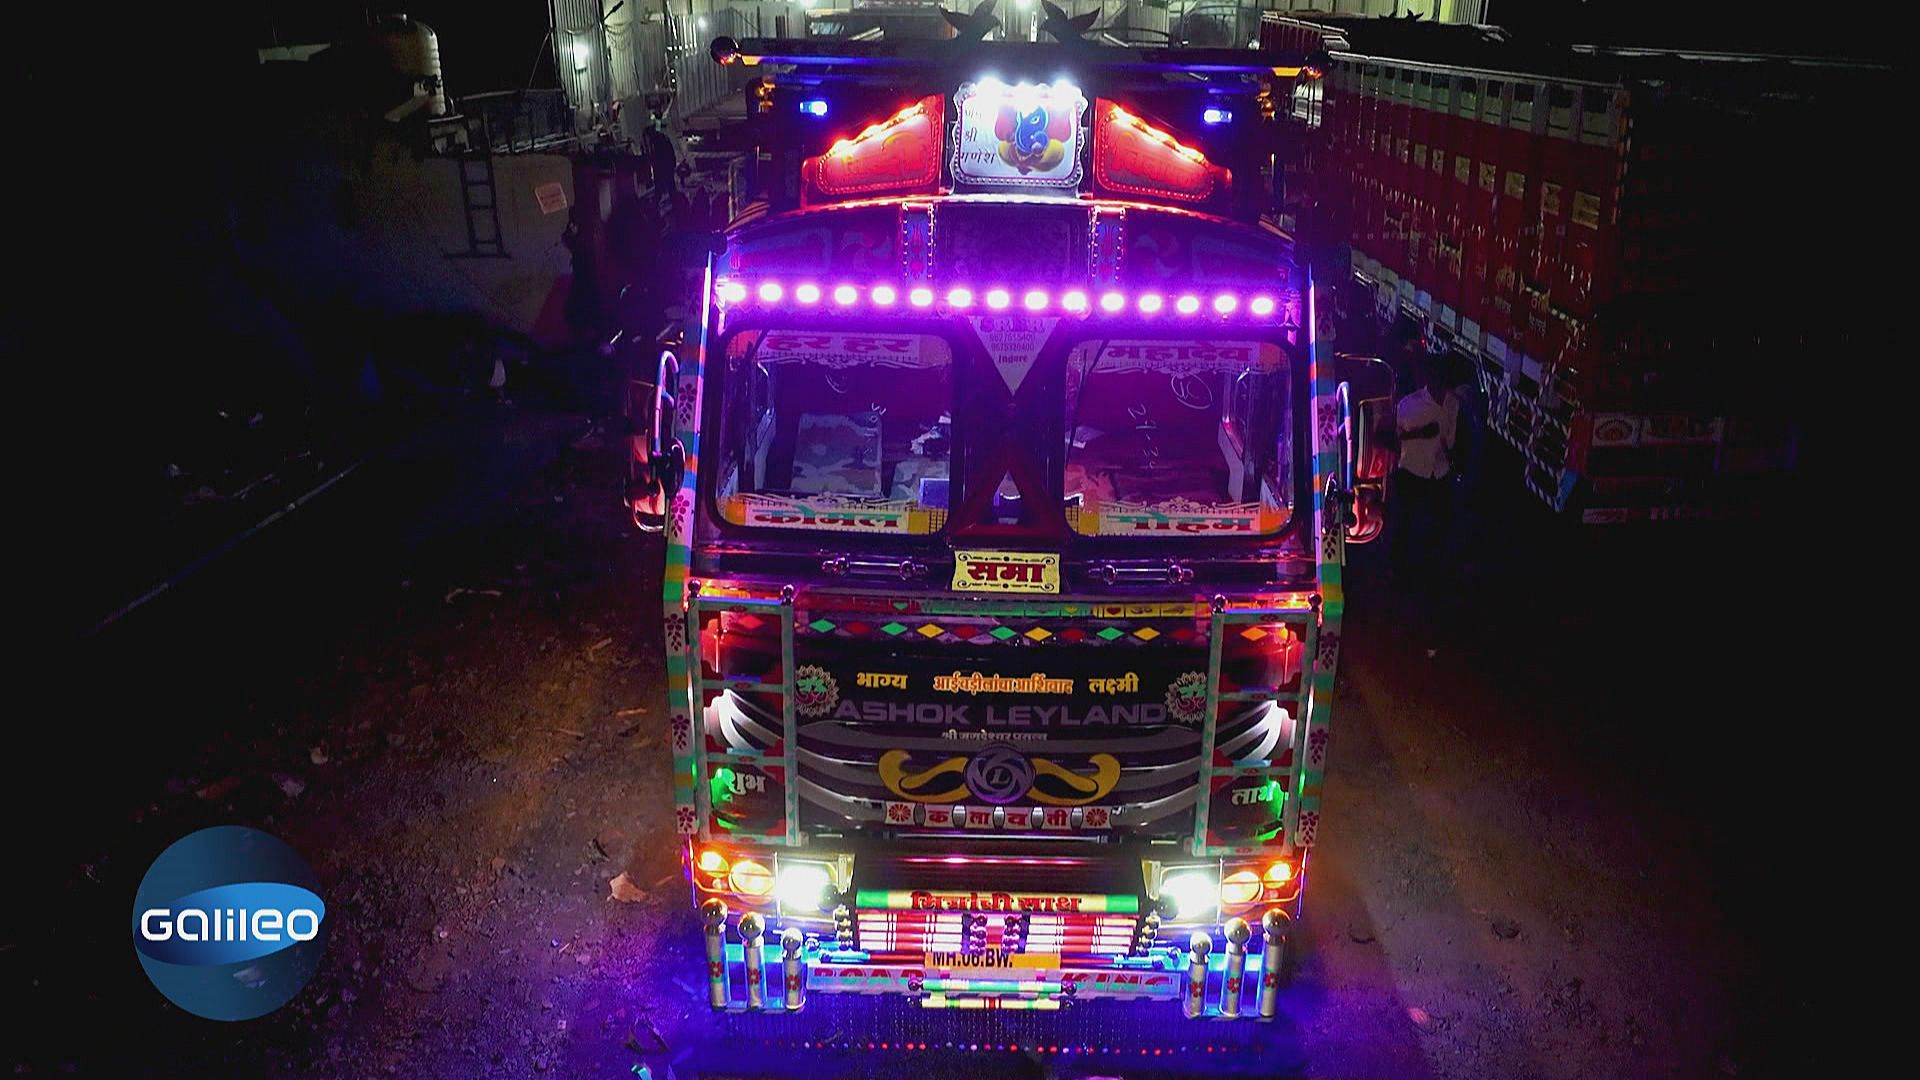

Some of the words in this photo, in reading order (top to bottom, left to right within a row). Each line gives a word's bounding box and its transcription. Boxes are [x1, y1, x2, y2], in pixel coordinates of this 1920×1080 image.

[767, 335, 832, 351] हर
[842, 337, 913, 353] हर
[1107, 340, 1252, 361] महादेव
[752, 504, 902, 528] कोमल
[966, 561, 1046, 583] समा
[857, 671, 908, 690] भाग्य
[1088, 671, 1140, 695] लक्ष्मी
[833, 700, 970, 724] ASHOK
[986, 703, 1168, 726] LEYLAND
[1231, 785, 1274, 806] लाभ
[814, 967, 927, 986] ROAD
[1061, 972, 1173, 994] KING
